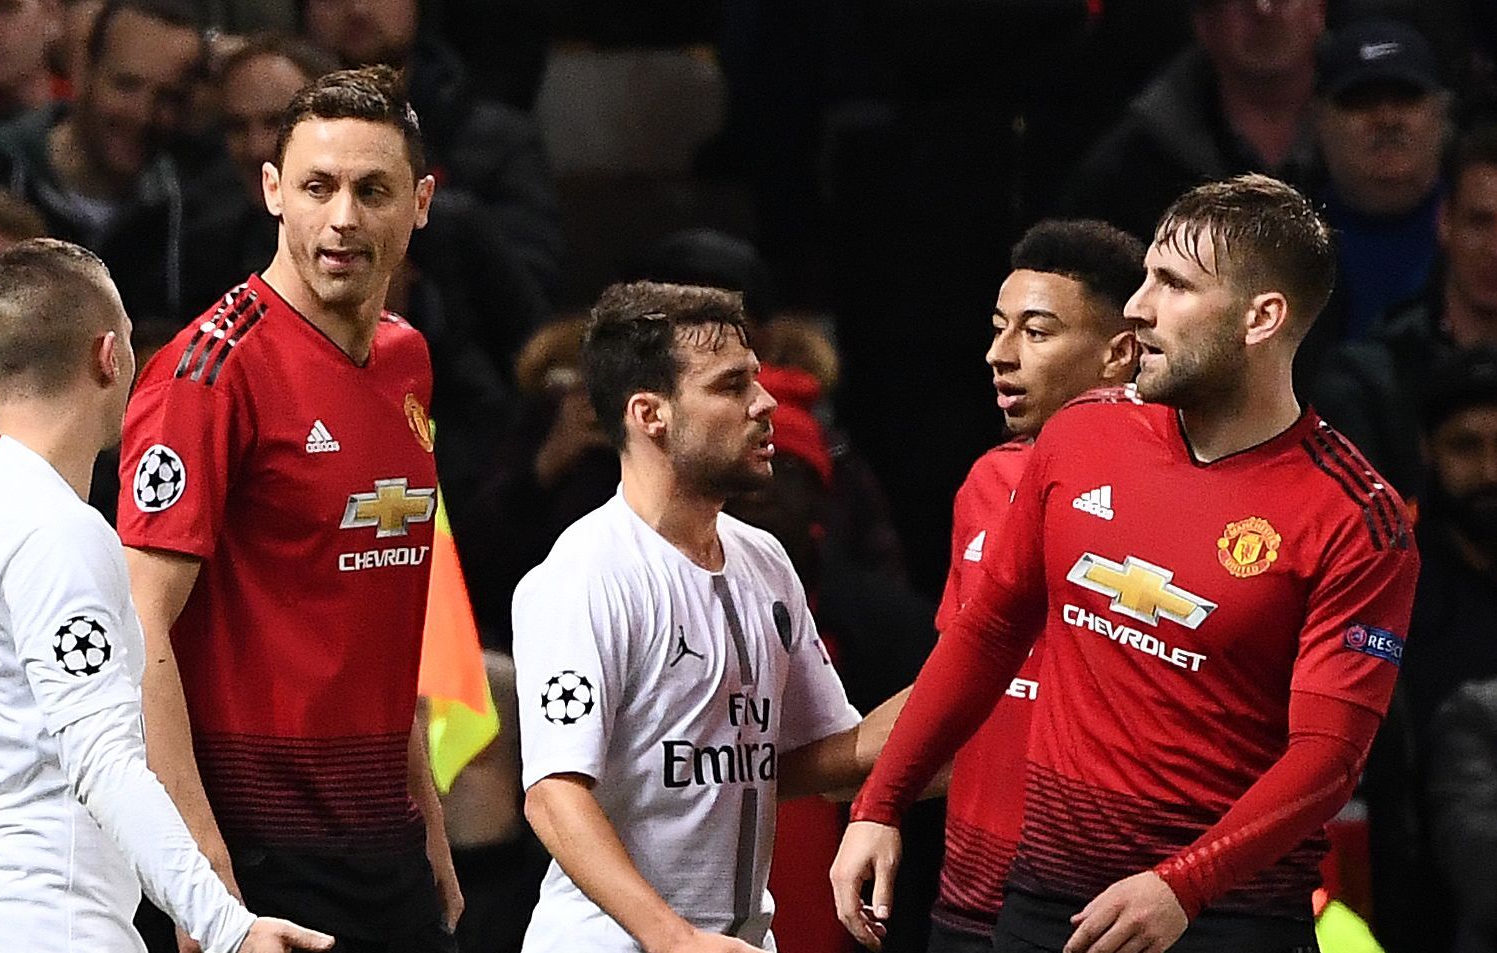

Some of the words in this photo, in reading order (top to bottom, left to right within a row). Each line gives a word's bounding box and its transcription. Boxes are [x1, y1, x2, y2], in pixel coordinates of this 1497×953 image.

[1062, 603, 1208, 672] CHEVROLET
[728, 692, 771, 733] Fly
[662, 731, 777, 789] Emira
